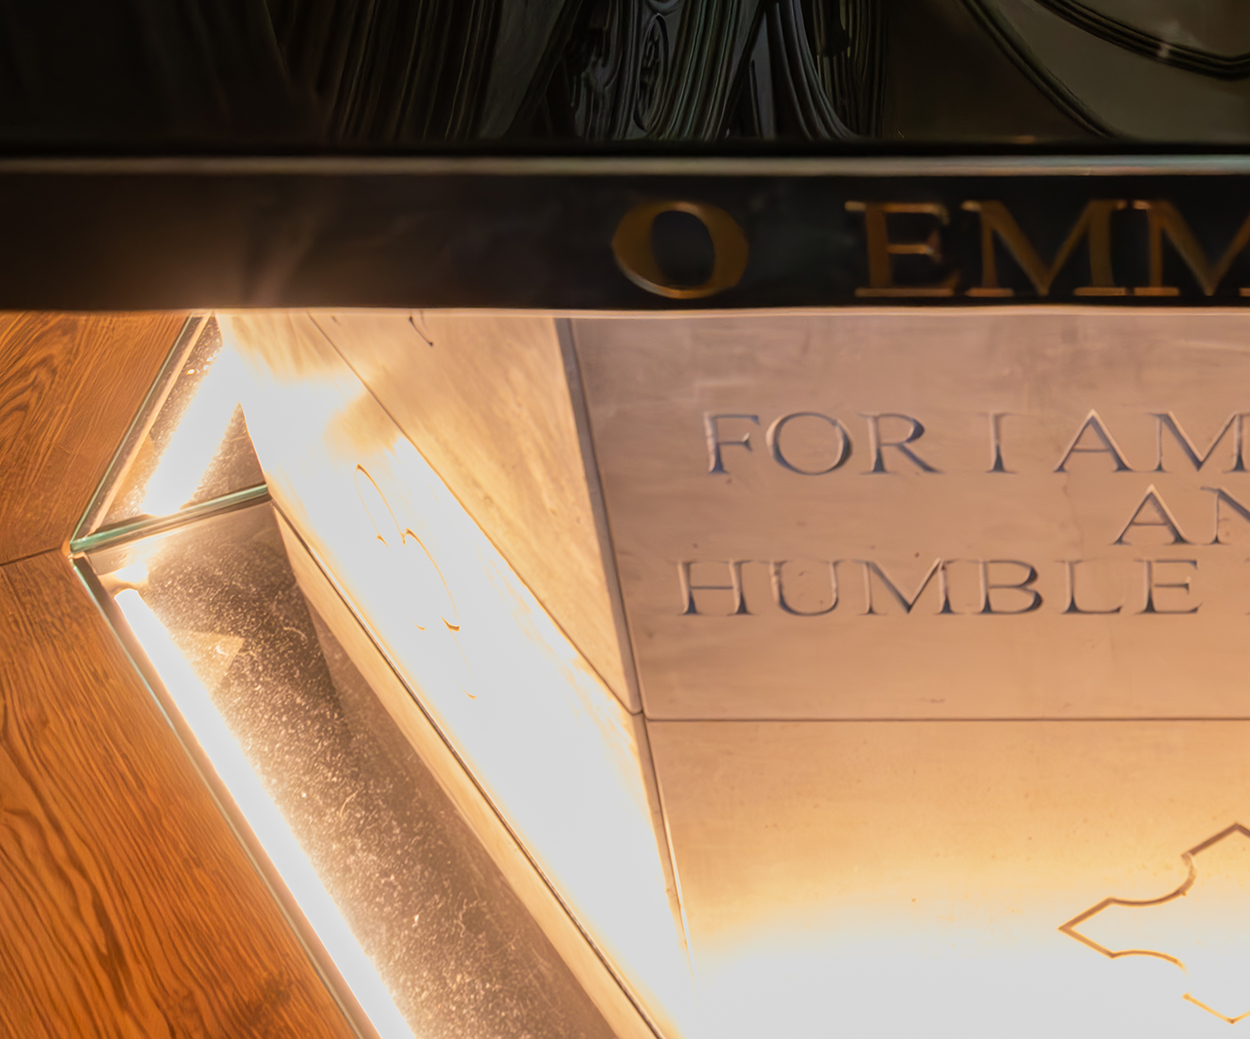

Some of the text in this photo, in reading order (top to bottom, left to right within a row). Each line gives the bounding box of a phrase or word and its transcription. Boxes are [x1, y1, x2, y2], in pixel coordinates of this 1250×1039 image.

[610, 199, 749, 299] O
[702, 411, 943, 476] FOR
[984, 411, 1018, 474] I
[676, 558, 1202, 617] HUMBLE
